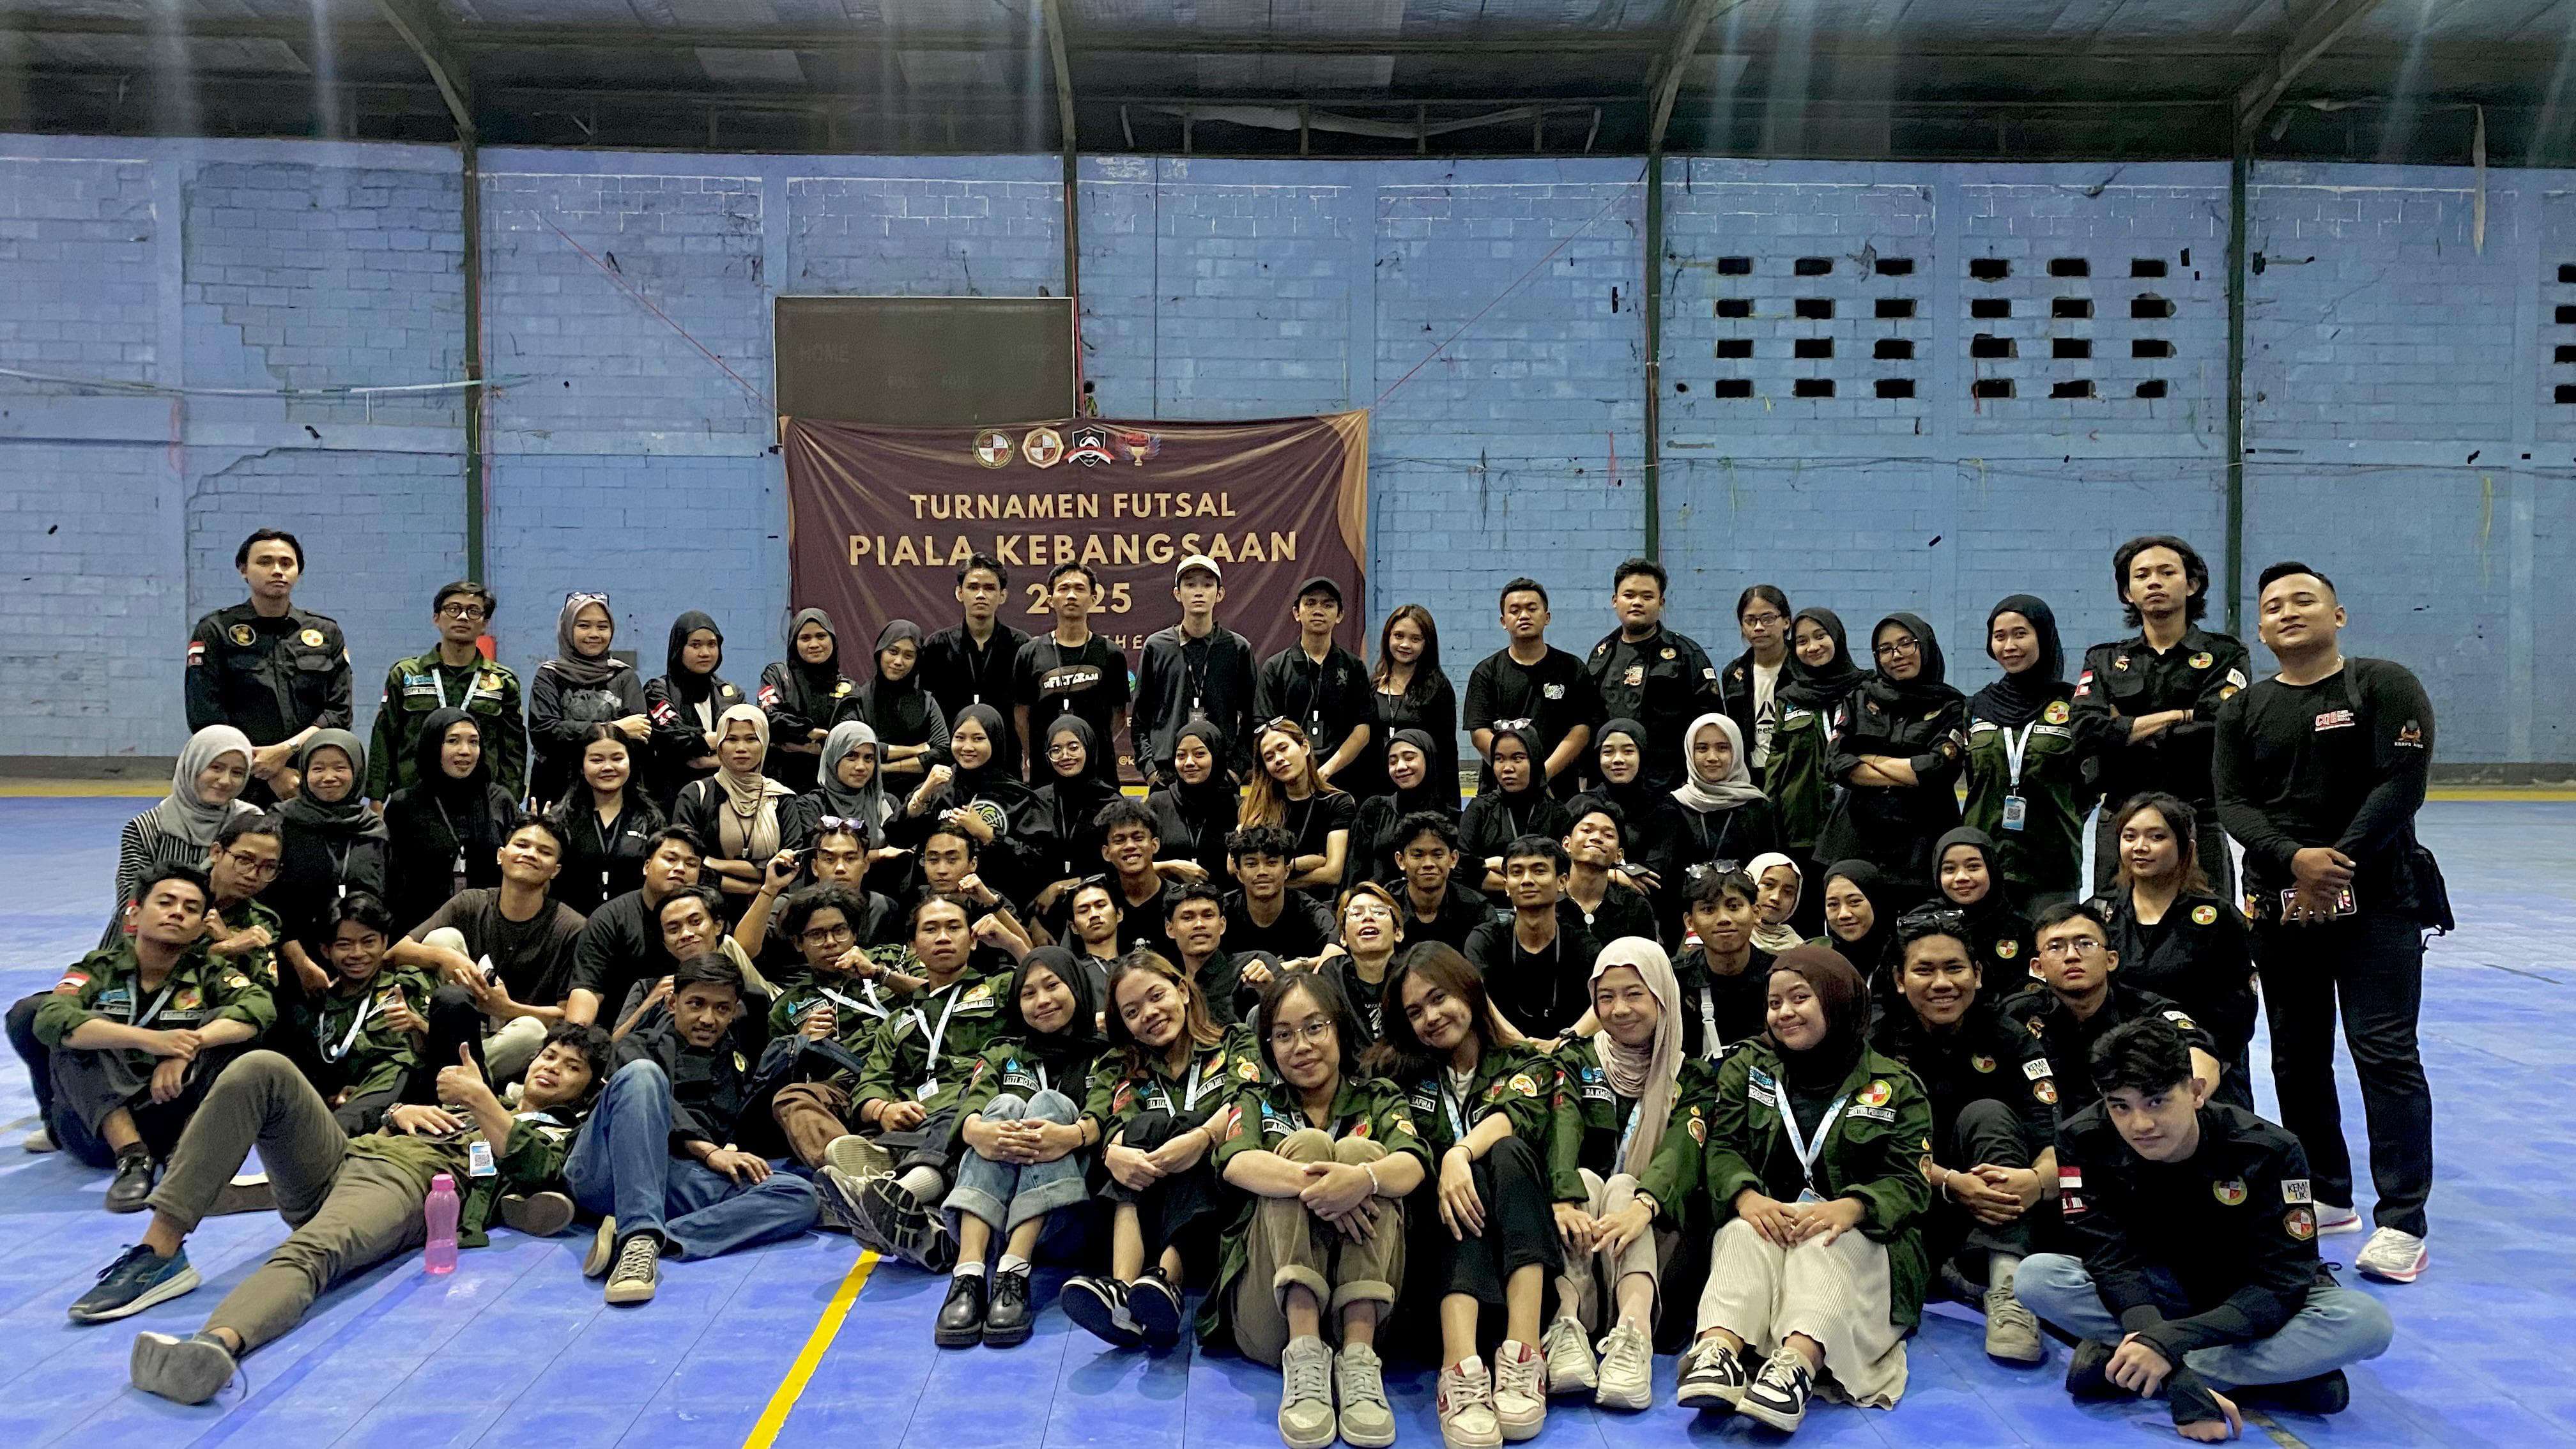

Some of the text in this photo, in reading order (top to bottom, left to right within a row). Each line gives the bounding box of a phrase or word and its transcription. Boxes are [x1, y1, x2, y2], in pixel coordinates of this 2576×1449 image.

[910, 492, 1236, 519] TURNAMEN FUTSAL
[849, 533, 1297, 566] PIALA KEBANGSAAN
[1026, 583, 1132, 614] 225
[1104, 634, 1142, 649] HE
[1411, 1096, 1432, 1110] SAFIRA
